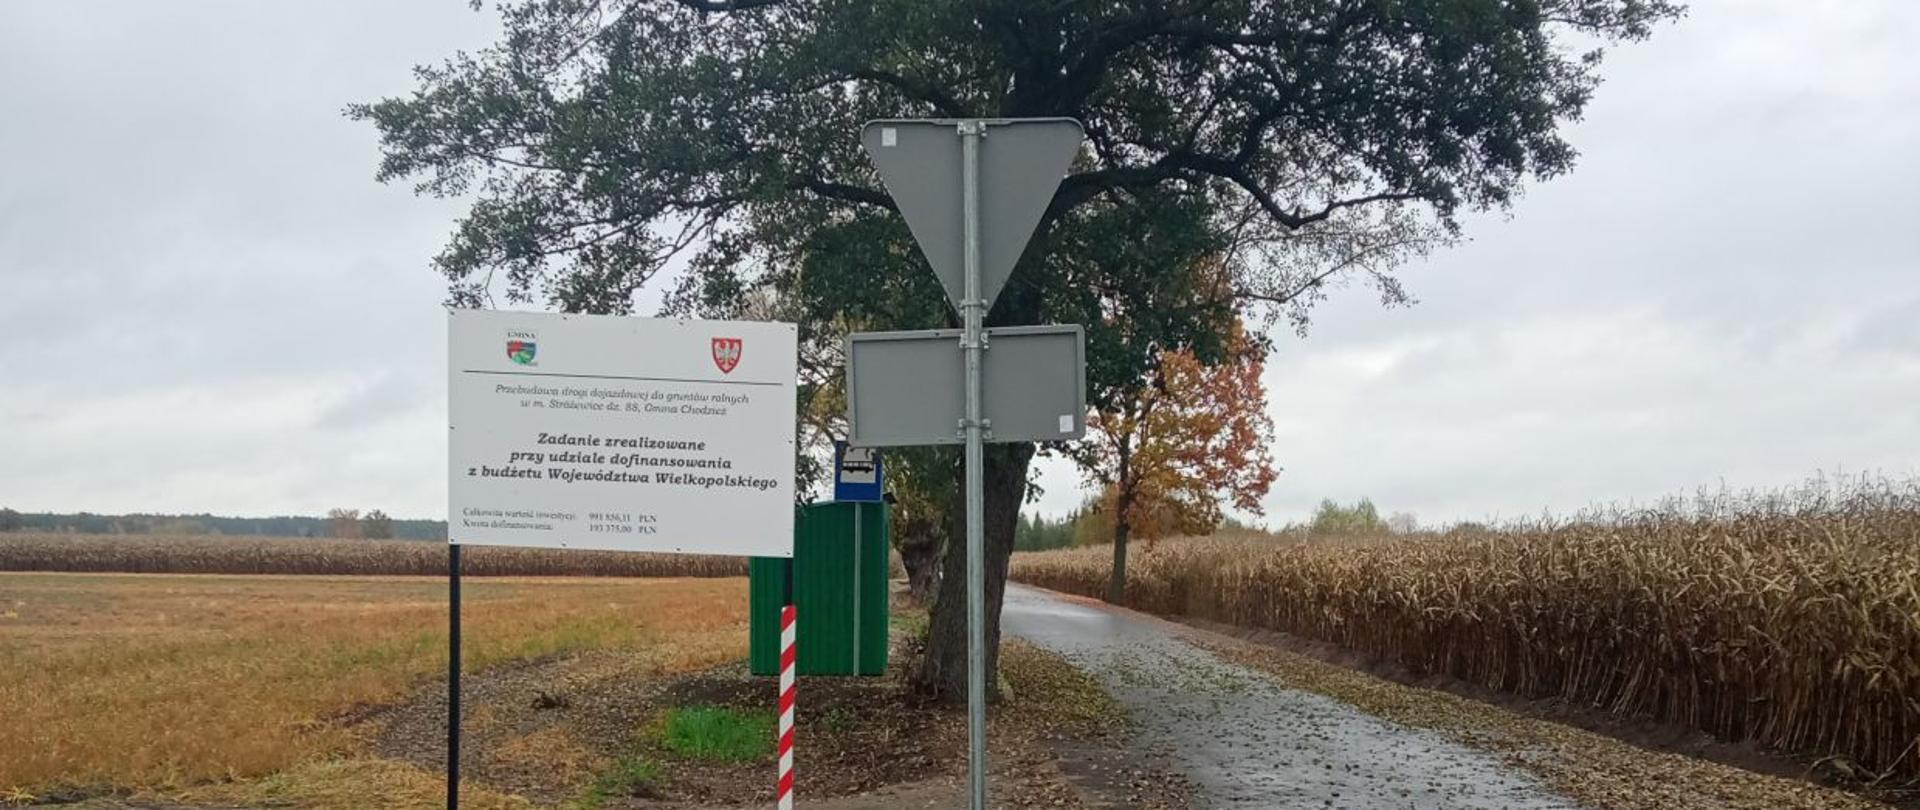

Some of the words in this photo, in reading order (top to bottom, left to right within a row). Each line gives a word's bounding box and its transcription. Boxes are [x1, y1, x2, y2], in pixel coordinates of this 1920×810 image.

[651, 390, 664, 400] do
[711, 393, 749, 404] rolnych
[520, 400, 530, 408] w
[644, 403, 678, 414] Gmina
[537, 433, 601, 446] Zadanie
[605, 437, 706, 450] zrealizowane
[509, 451, 545, 464] przy
[549, 451, 605, 464] udziale
[610, 453, 732, 469] dofinansowania
[468, 467, 477, 476] z
[481, 465, 542, 479] budżetu
[548, 468, 649, 483] Województwa
[655, 472, 778, 491] Wielkopolskiego
